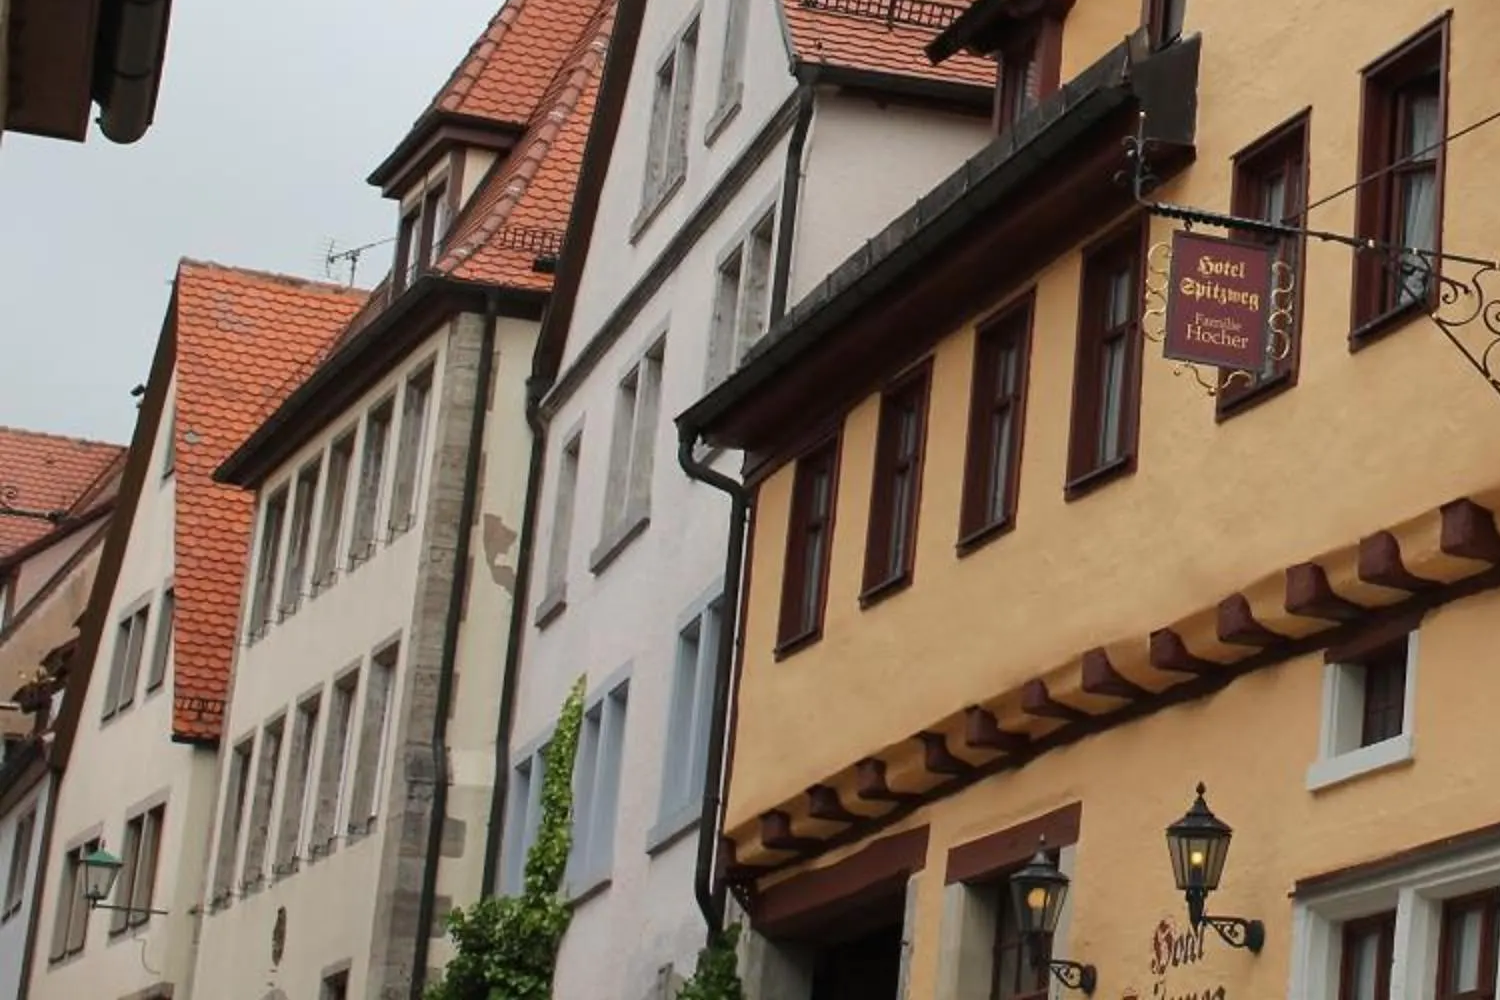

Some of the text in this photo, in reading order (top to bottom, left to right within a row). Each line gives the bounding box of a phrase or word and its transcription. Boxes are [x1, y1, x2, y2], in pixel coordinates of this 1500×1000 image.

[1197, 255, 1245, 279] Hotel
[1179, 277, 1260, 311] Spitzweg
[1195, 312, 1243, 331] Familie
[1186, 323, 1249, 349] Hocher
